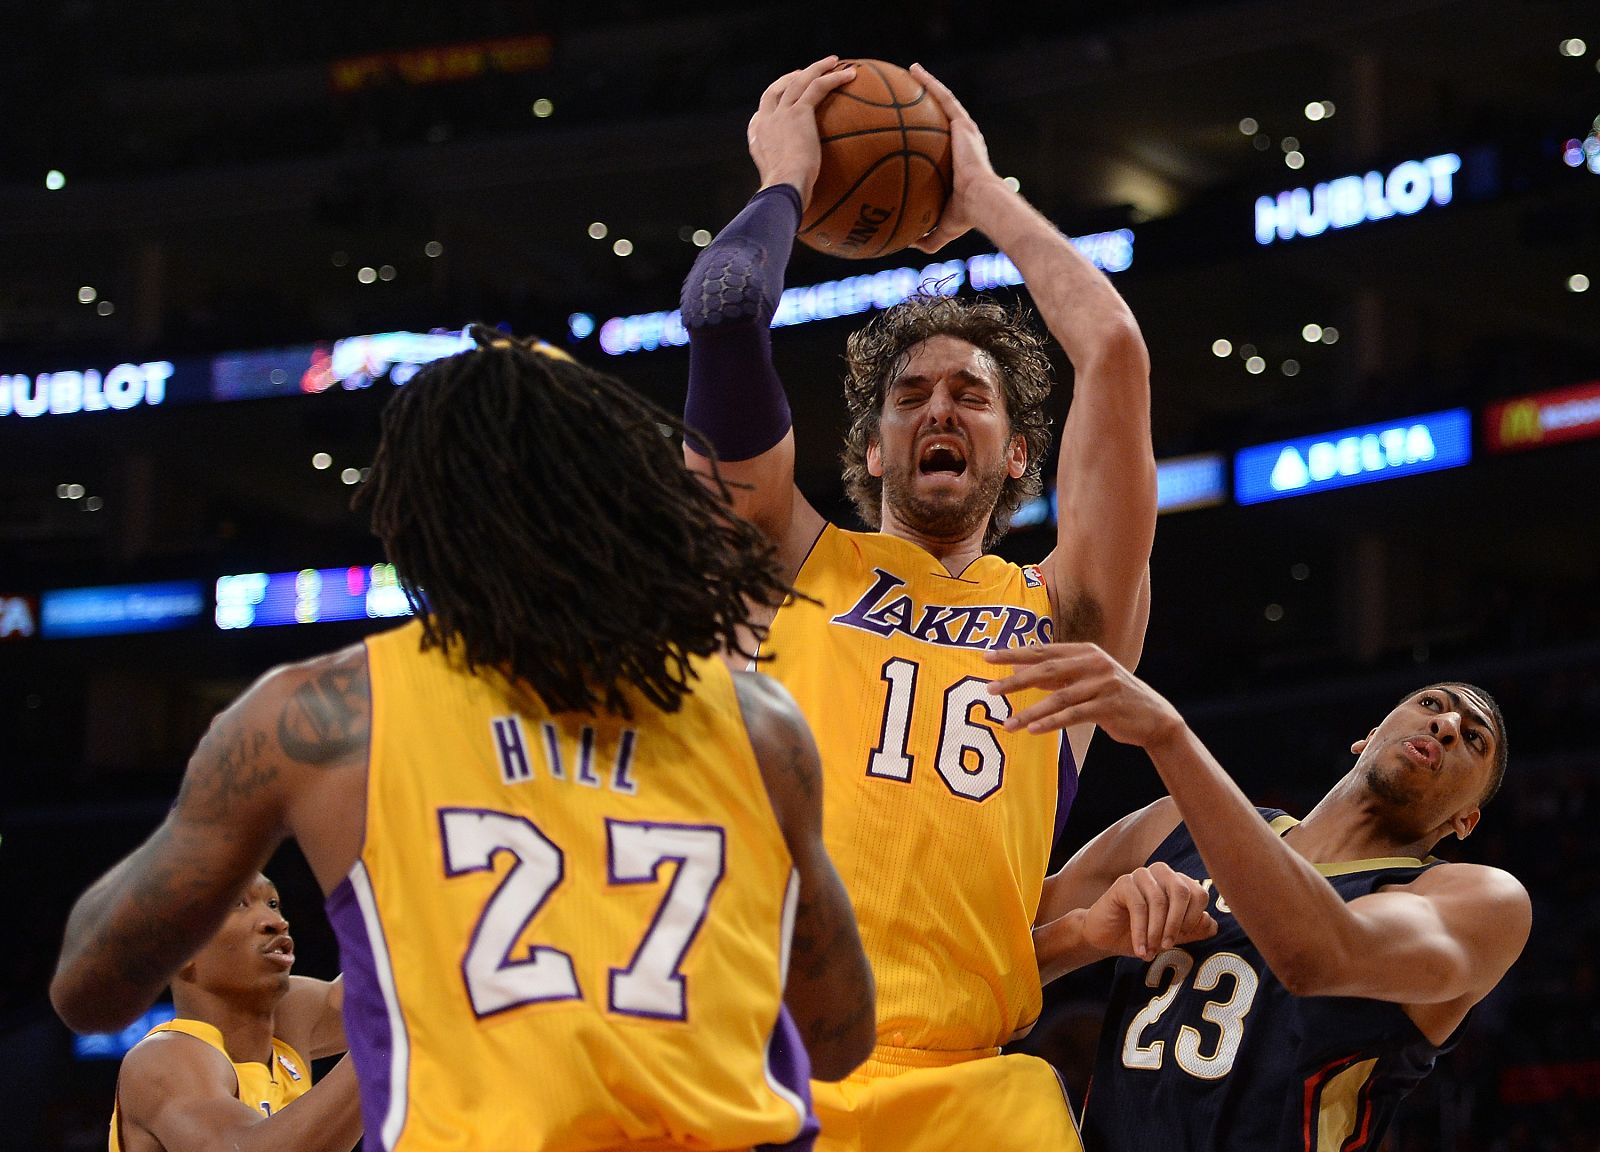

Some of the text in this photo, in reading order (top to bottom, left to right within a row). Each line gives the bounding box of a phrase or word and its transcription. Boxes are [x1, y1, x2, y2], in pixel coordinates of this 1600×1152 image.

[1255, 153, 1461, 245] HUBLOT
[1308, 424, 1435, 482] DELTA
[830, 567, 1055, 651] LAKERS
[490, 713, 638, 796] HILL
[866, 656, 1012, 803] 16
[437, 806, 726, 1023] 27
[1122, 948, 1259, 1080] 23
